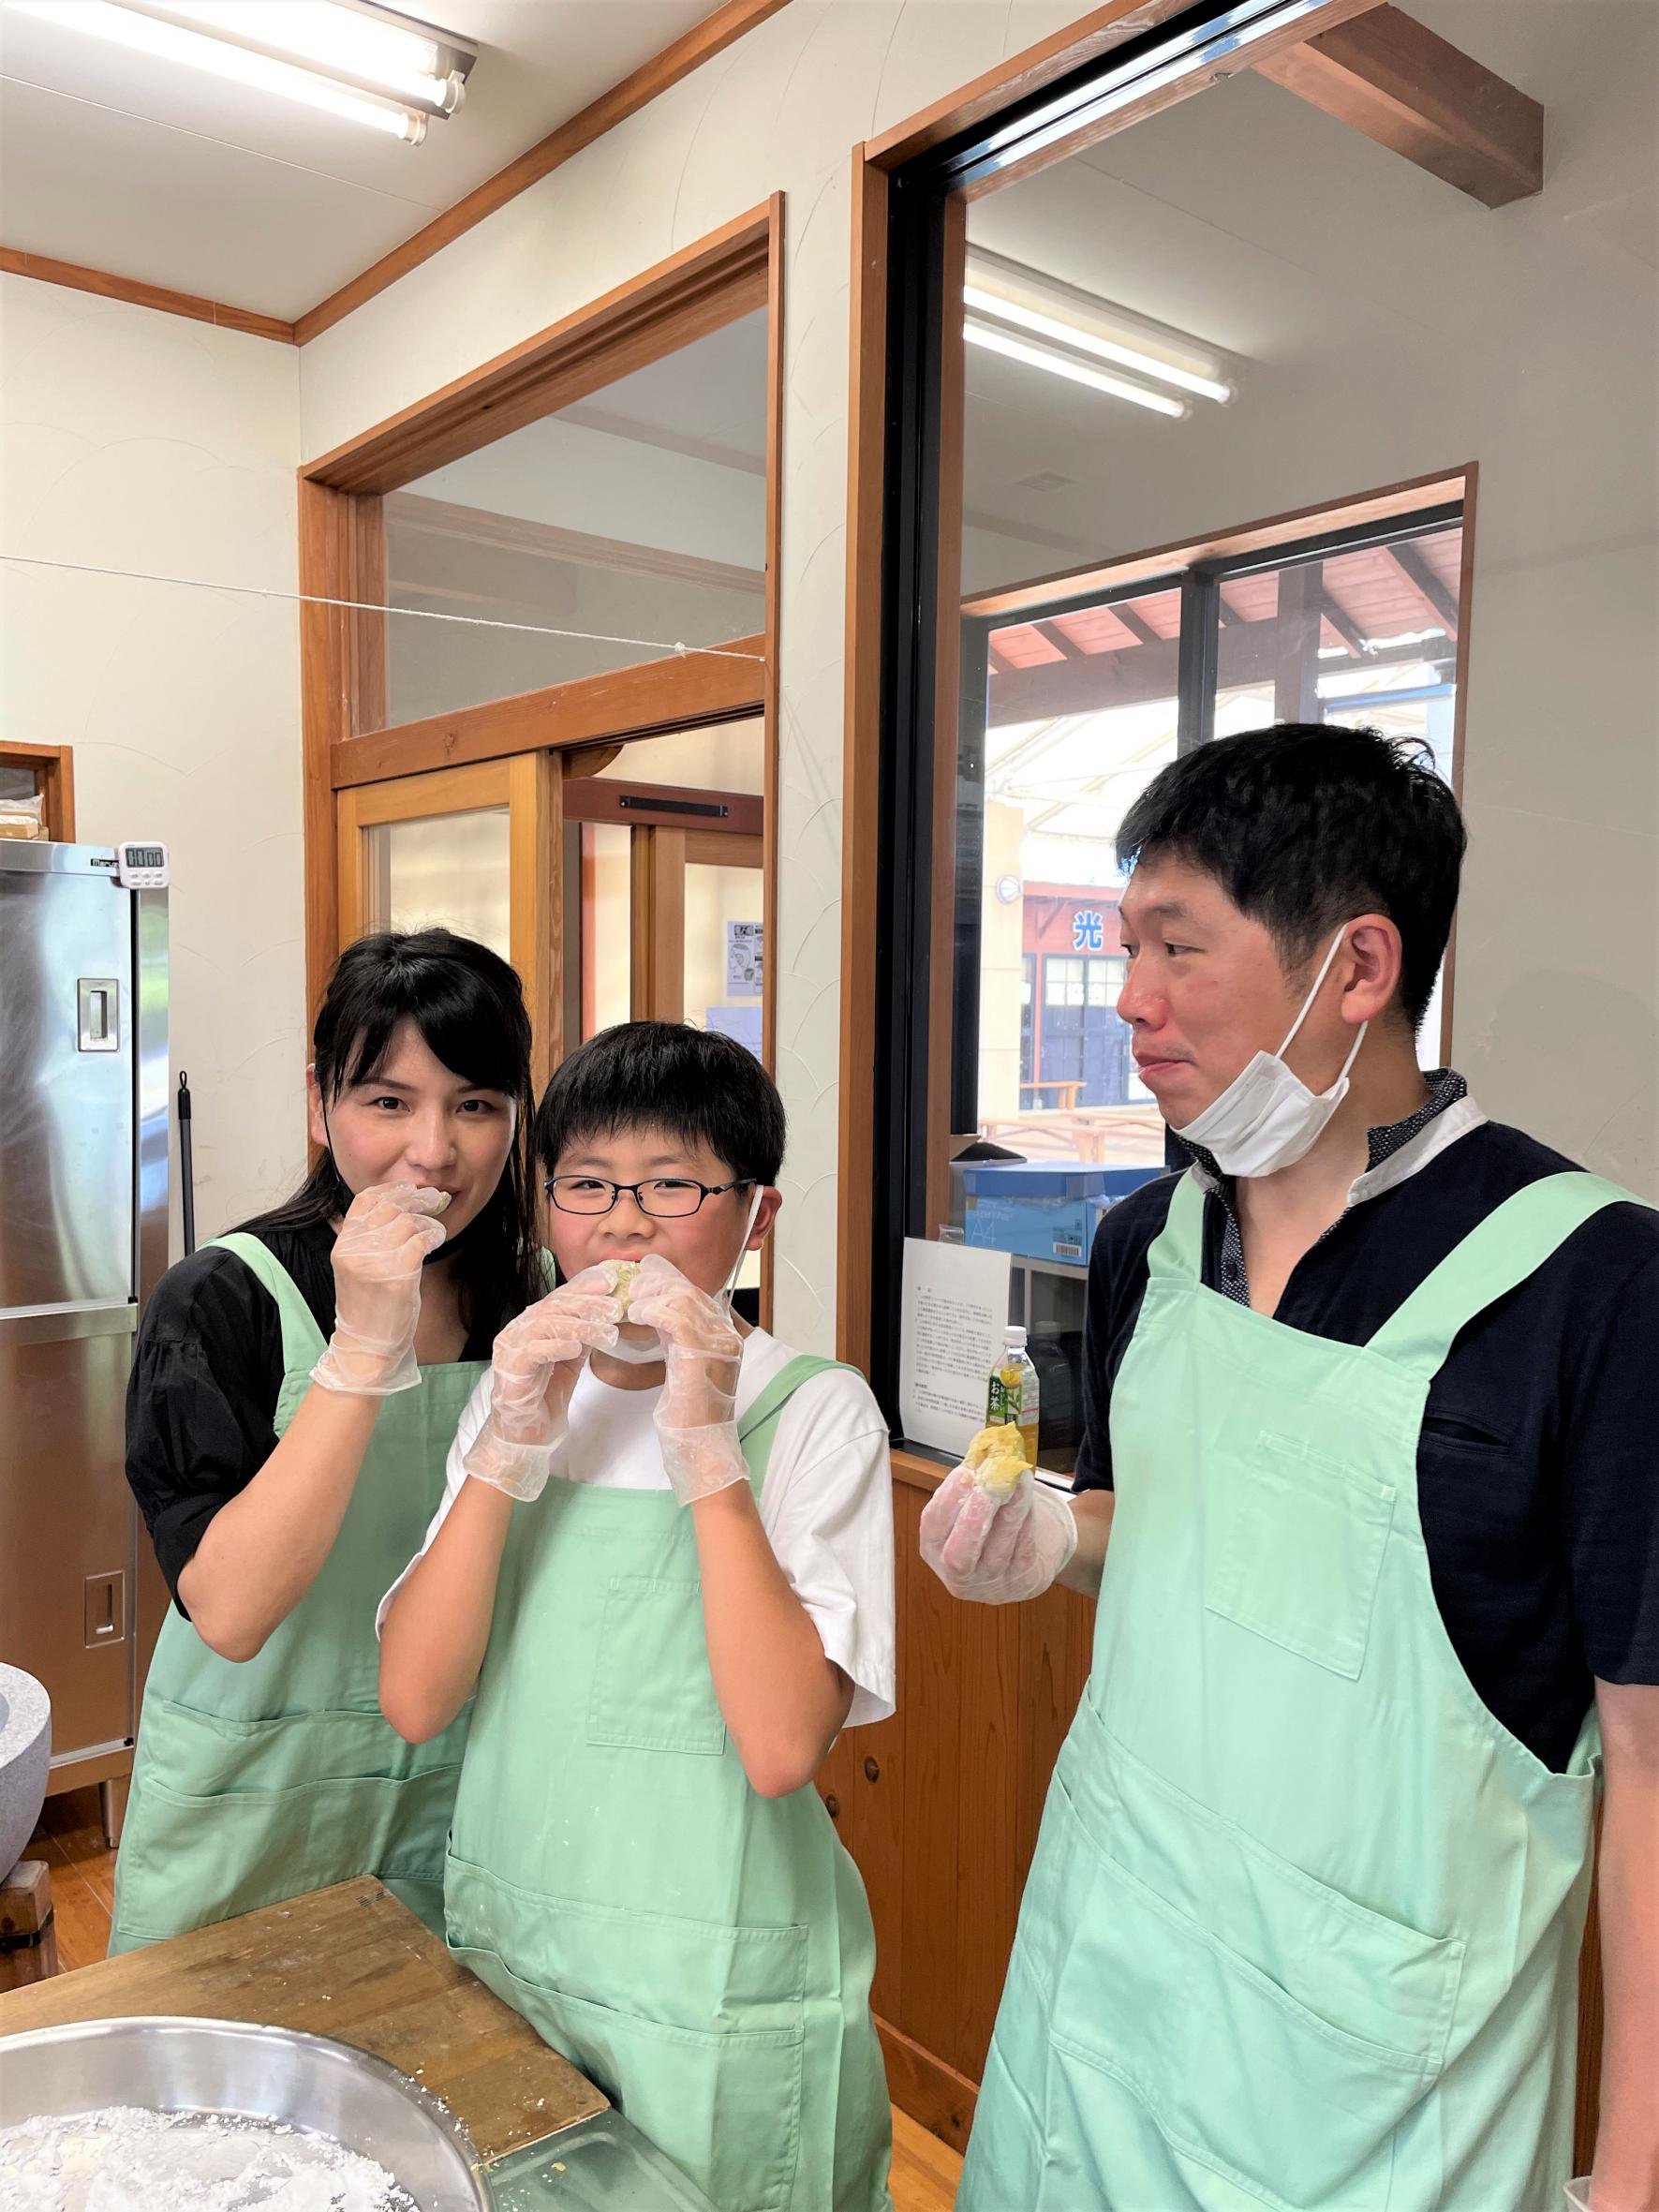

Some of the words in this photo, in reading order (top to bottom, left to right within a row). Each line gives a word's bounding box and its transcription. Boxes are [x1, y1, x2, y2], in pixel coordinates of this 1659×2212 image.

[1074, 912, 1104, 950] 光
[970, 1219, 997, 1244] A4
[990, 1381, 1000, 1411] お茶
